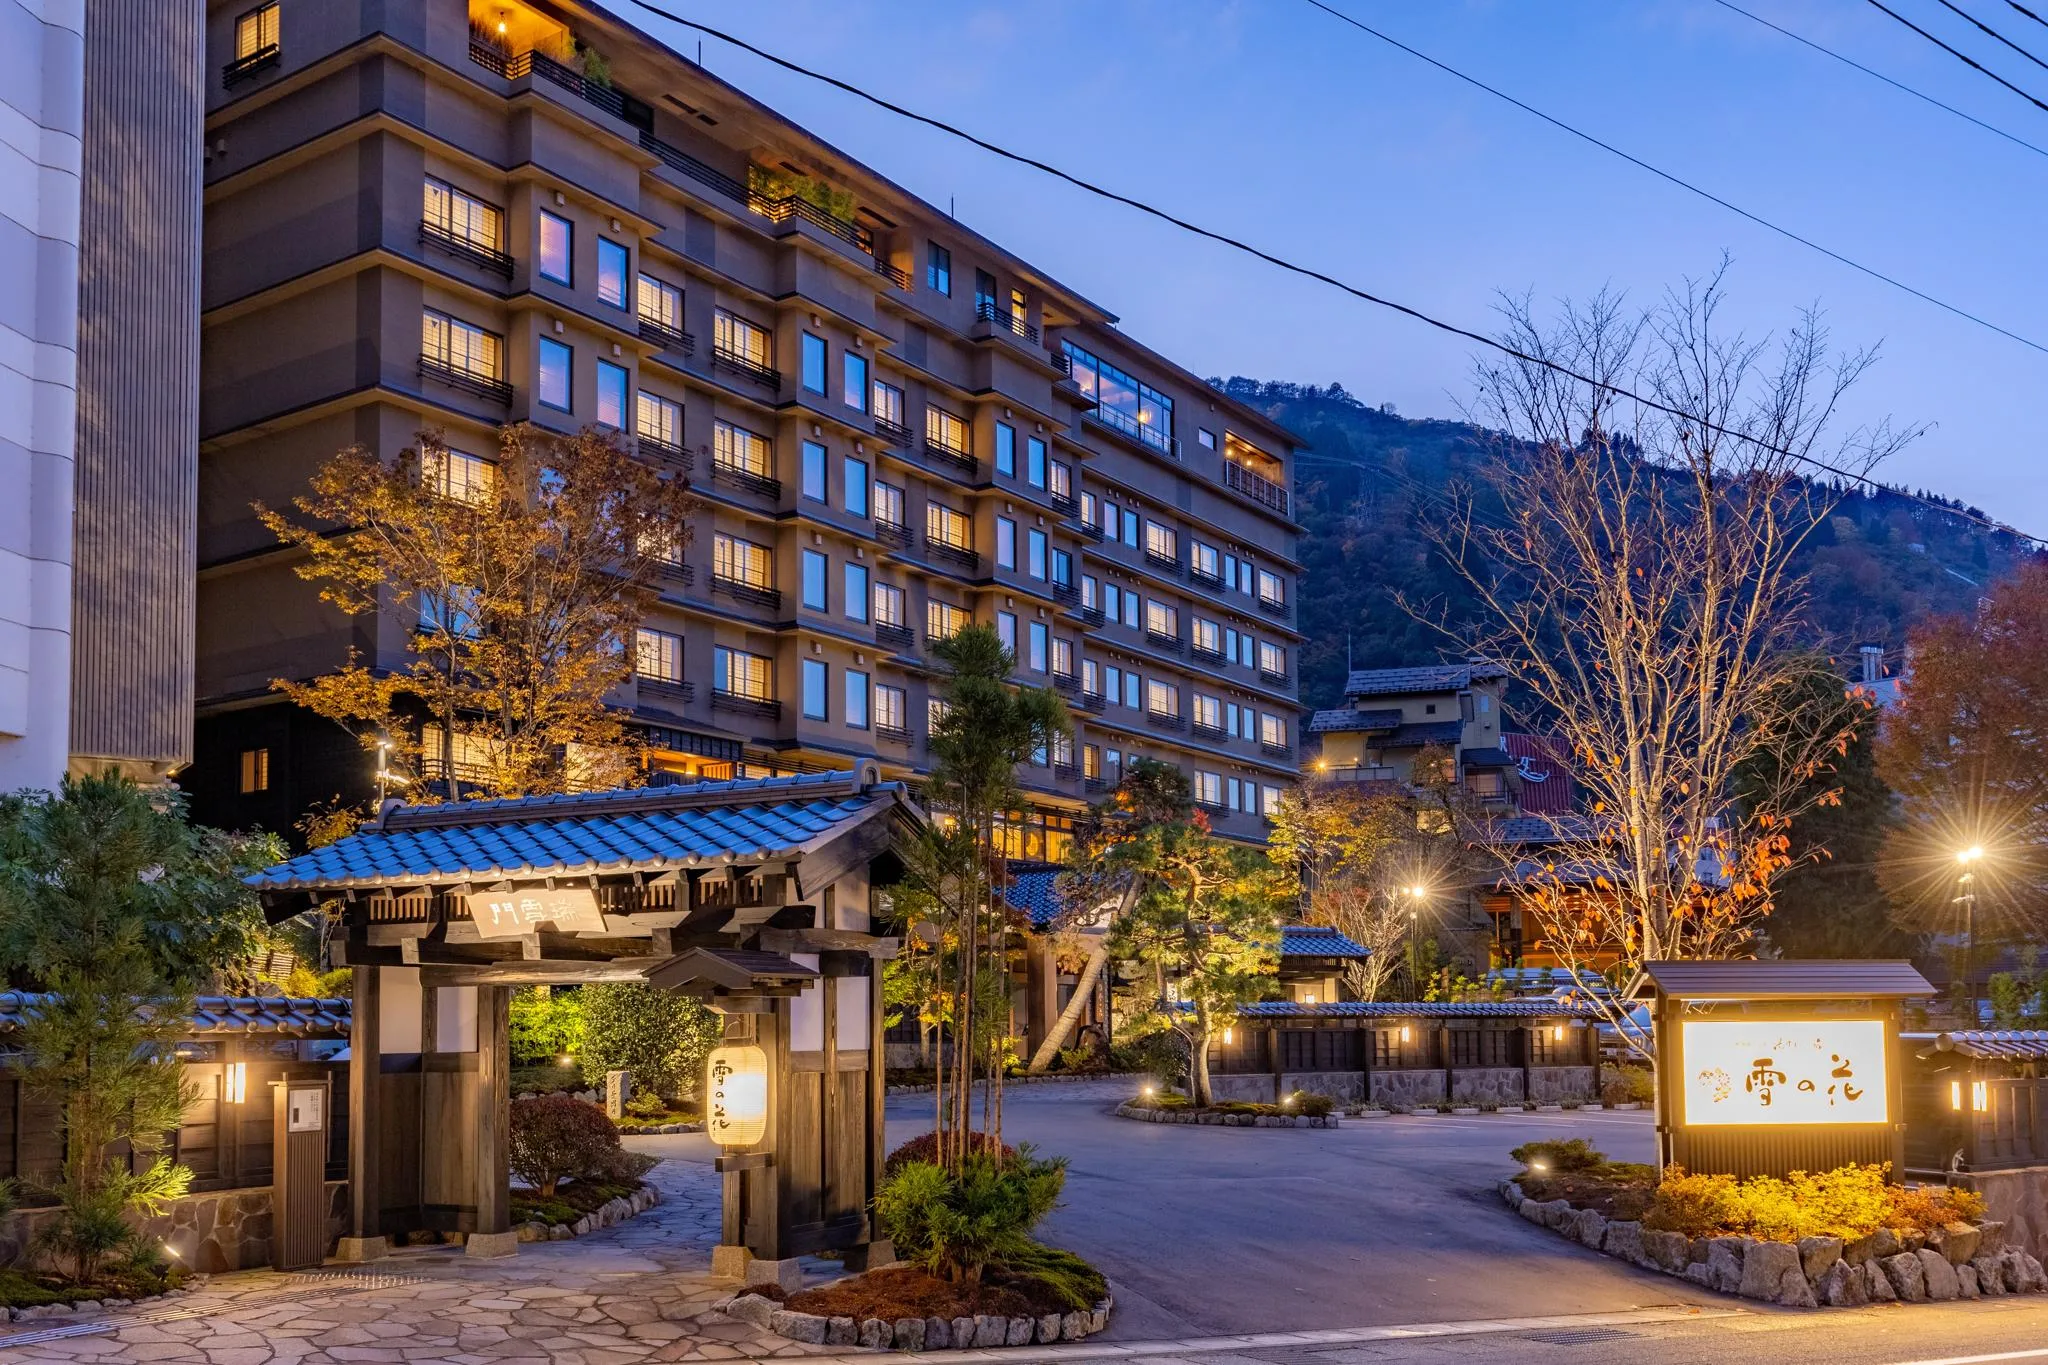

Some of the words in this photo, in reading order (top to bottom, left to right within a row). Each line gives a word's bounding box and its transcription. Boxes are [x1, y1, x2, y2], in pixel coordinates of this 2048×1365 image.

[711, 1059, 733, 1137] 雪の花
[1745, 1054, 1864, 1106] 雪の花
